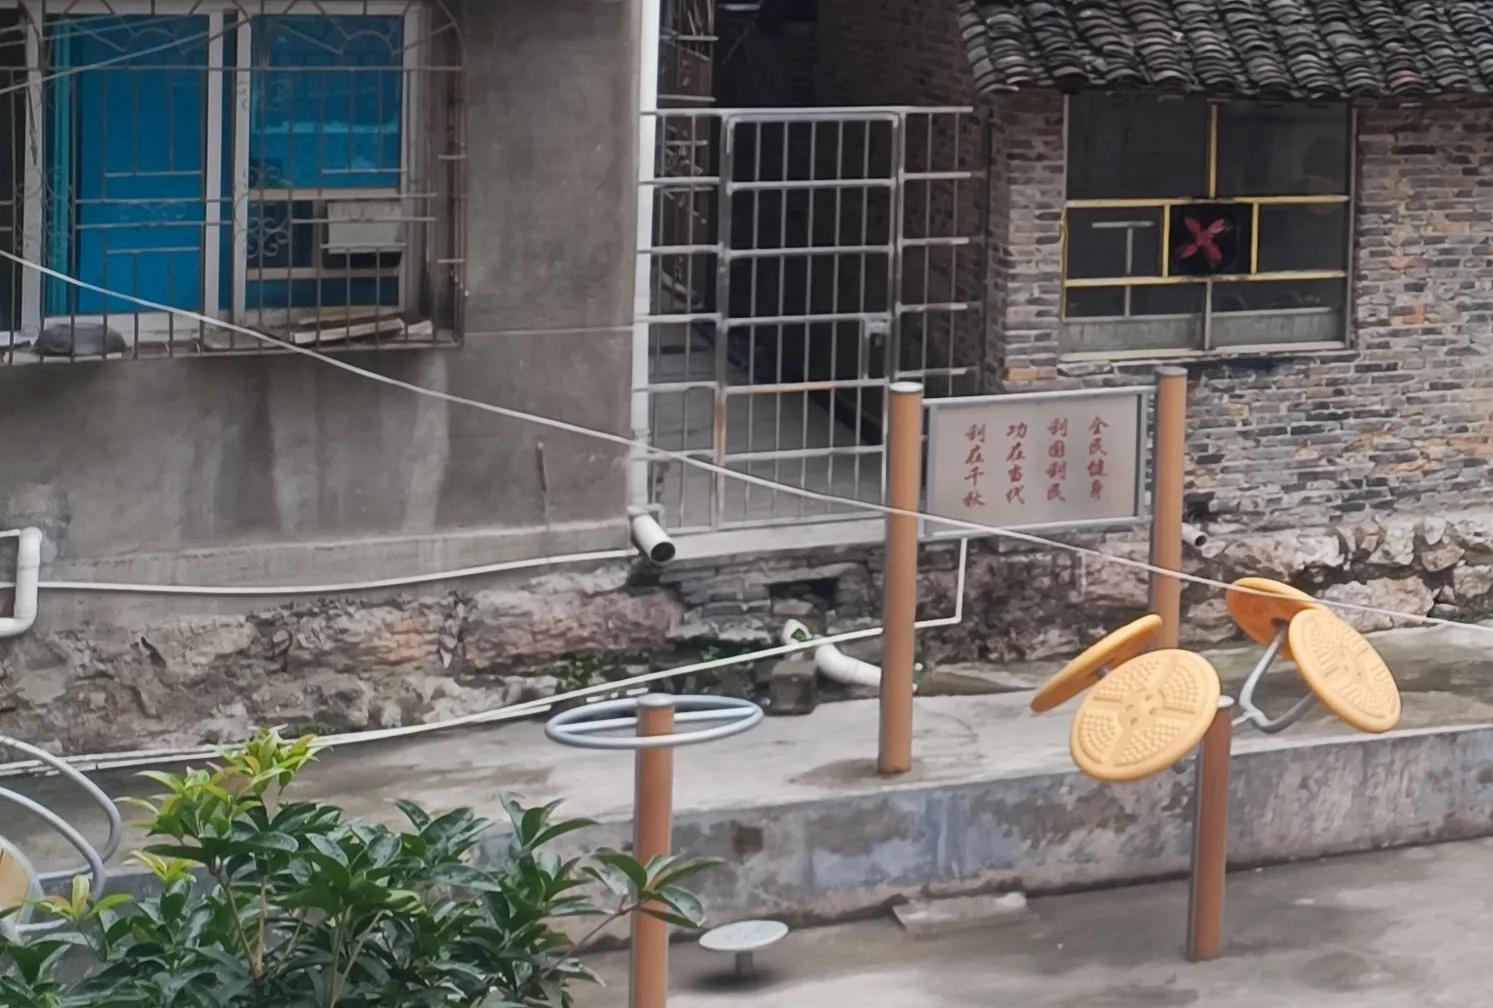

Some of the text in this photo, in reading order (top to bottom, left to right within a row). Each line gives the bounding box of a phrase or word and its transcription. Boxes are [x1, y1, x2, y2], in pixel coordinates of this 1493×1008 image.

[963, 423, 986, 507] 利在千秋
[1005, 422, 1028, 504] 功在当代
[1046, 418, 1068, 501] 利国利民
[1087, 416, 1109, 499] 全民健身
